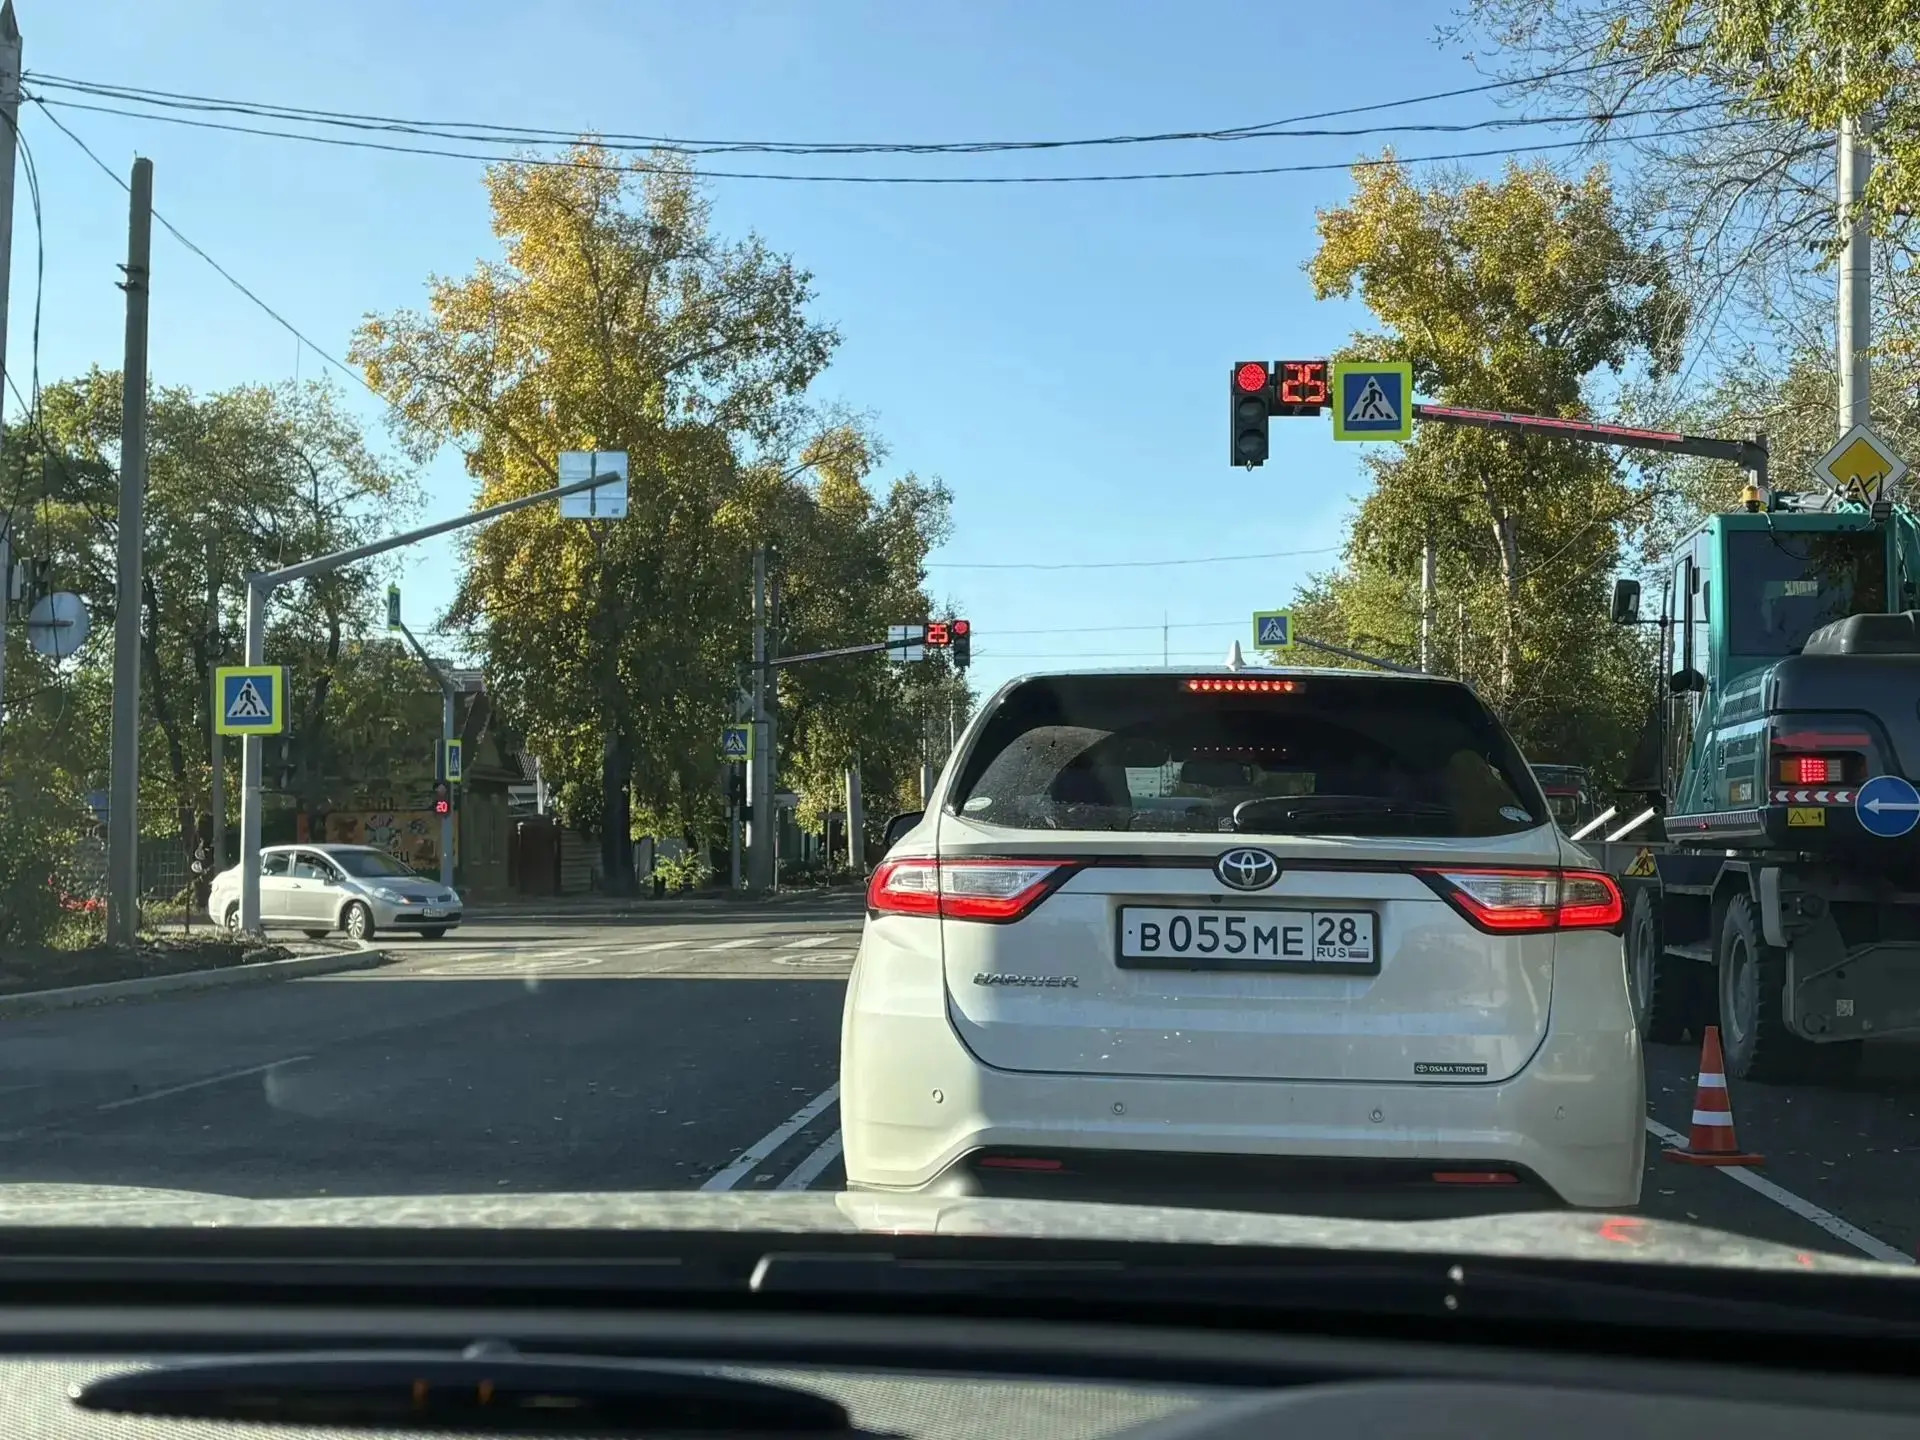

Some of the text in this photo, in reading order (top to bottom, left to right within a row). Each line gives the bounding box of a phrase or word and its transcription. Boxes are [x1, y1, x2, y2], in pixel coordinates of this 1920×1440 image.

[1282, 363, 1325, 402] 25
[928, 624, 949, 643] 25
[1317, 917, 1357, 946] 28
[1316, 947, 1346, 958] RUS
[973, 971, 1079, 988] HARRIER
[1429, 1065, 1454, 1073] OSAKA
